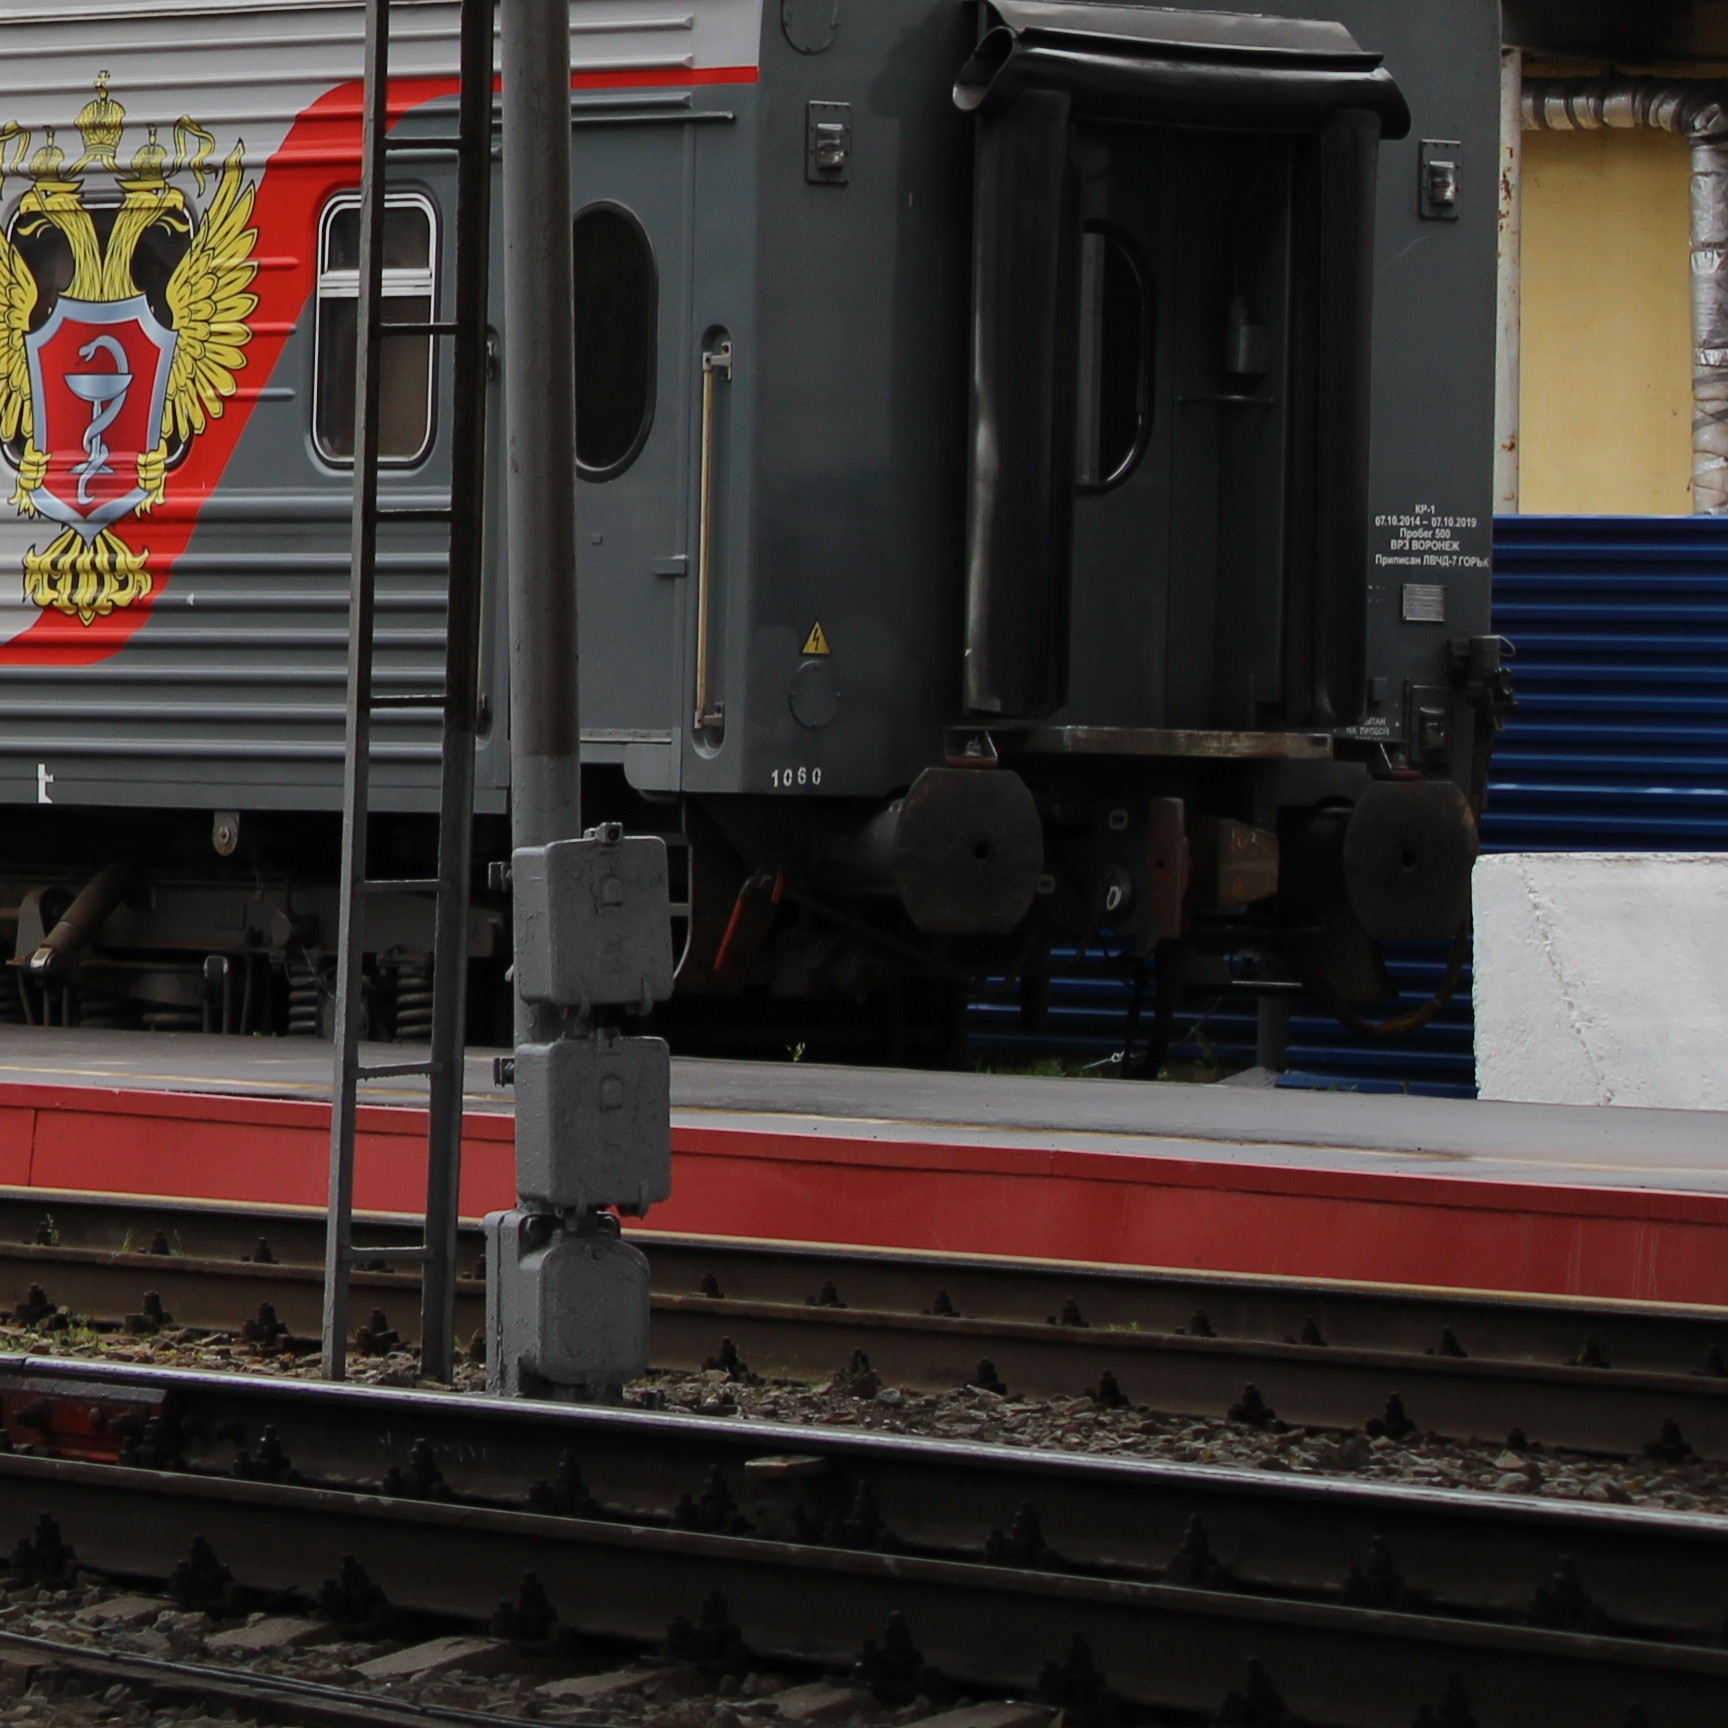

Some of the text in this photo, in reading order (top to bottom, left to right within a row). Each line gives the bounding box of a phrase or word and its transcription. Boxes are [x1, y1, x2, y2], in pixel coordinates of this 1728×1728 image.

[1415, 504, 1435, 514] КР-1
[1375, 515, 1421, 527] 07.10.2014
[1431, 517, 1477, 528] 07.10.2019
[1400, 528, 1451, 540] Пробег 500
[1390, 539, 1460, 551] ВРЗ ВОРОНЕЖ
[1375, 554, 1421, 567] Приписан
[1423, 555, 1457, 567] ЛВЧД-7
[771, 766, 822, 788] 1060
